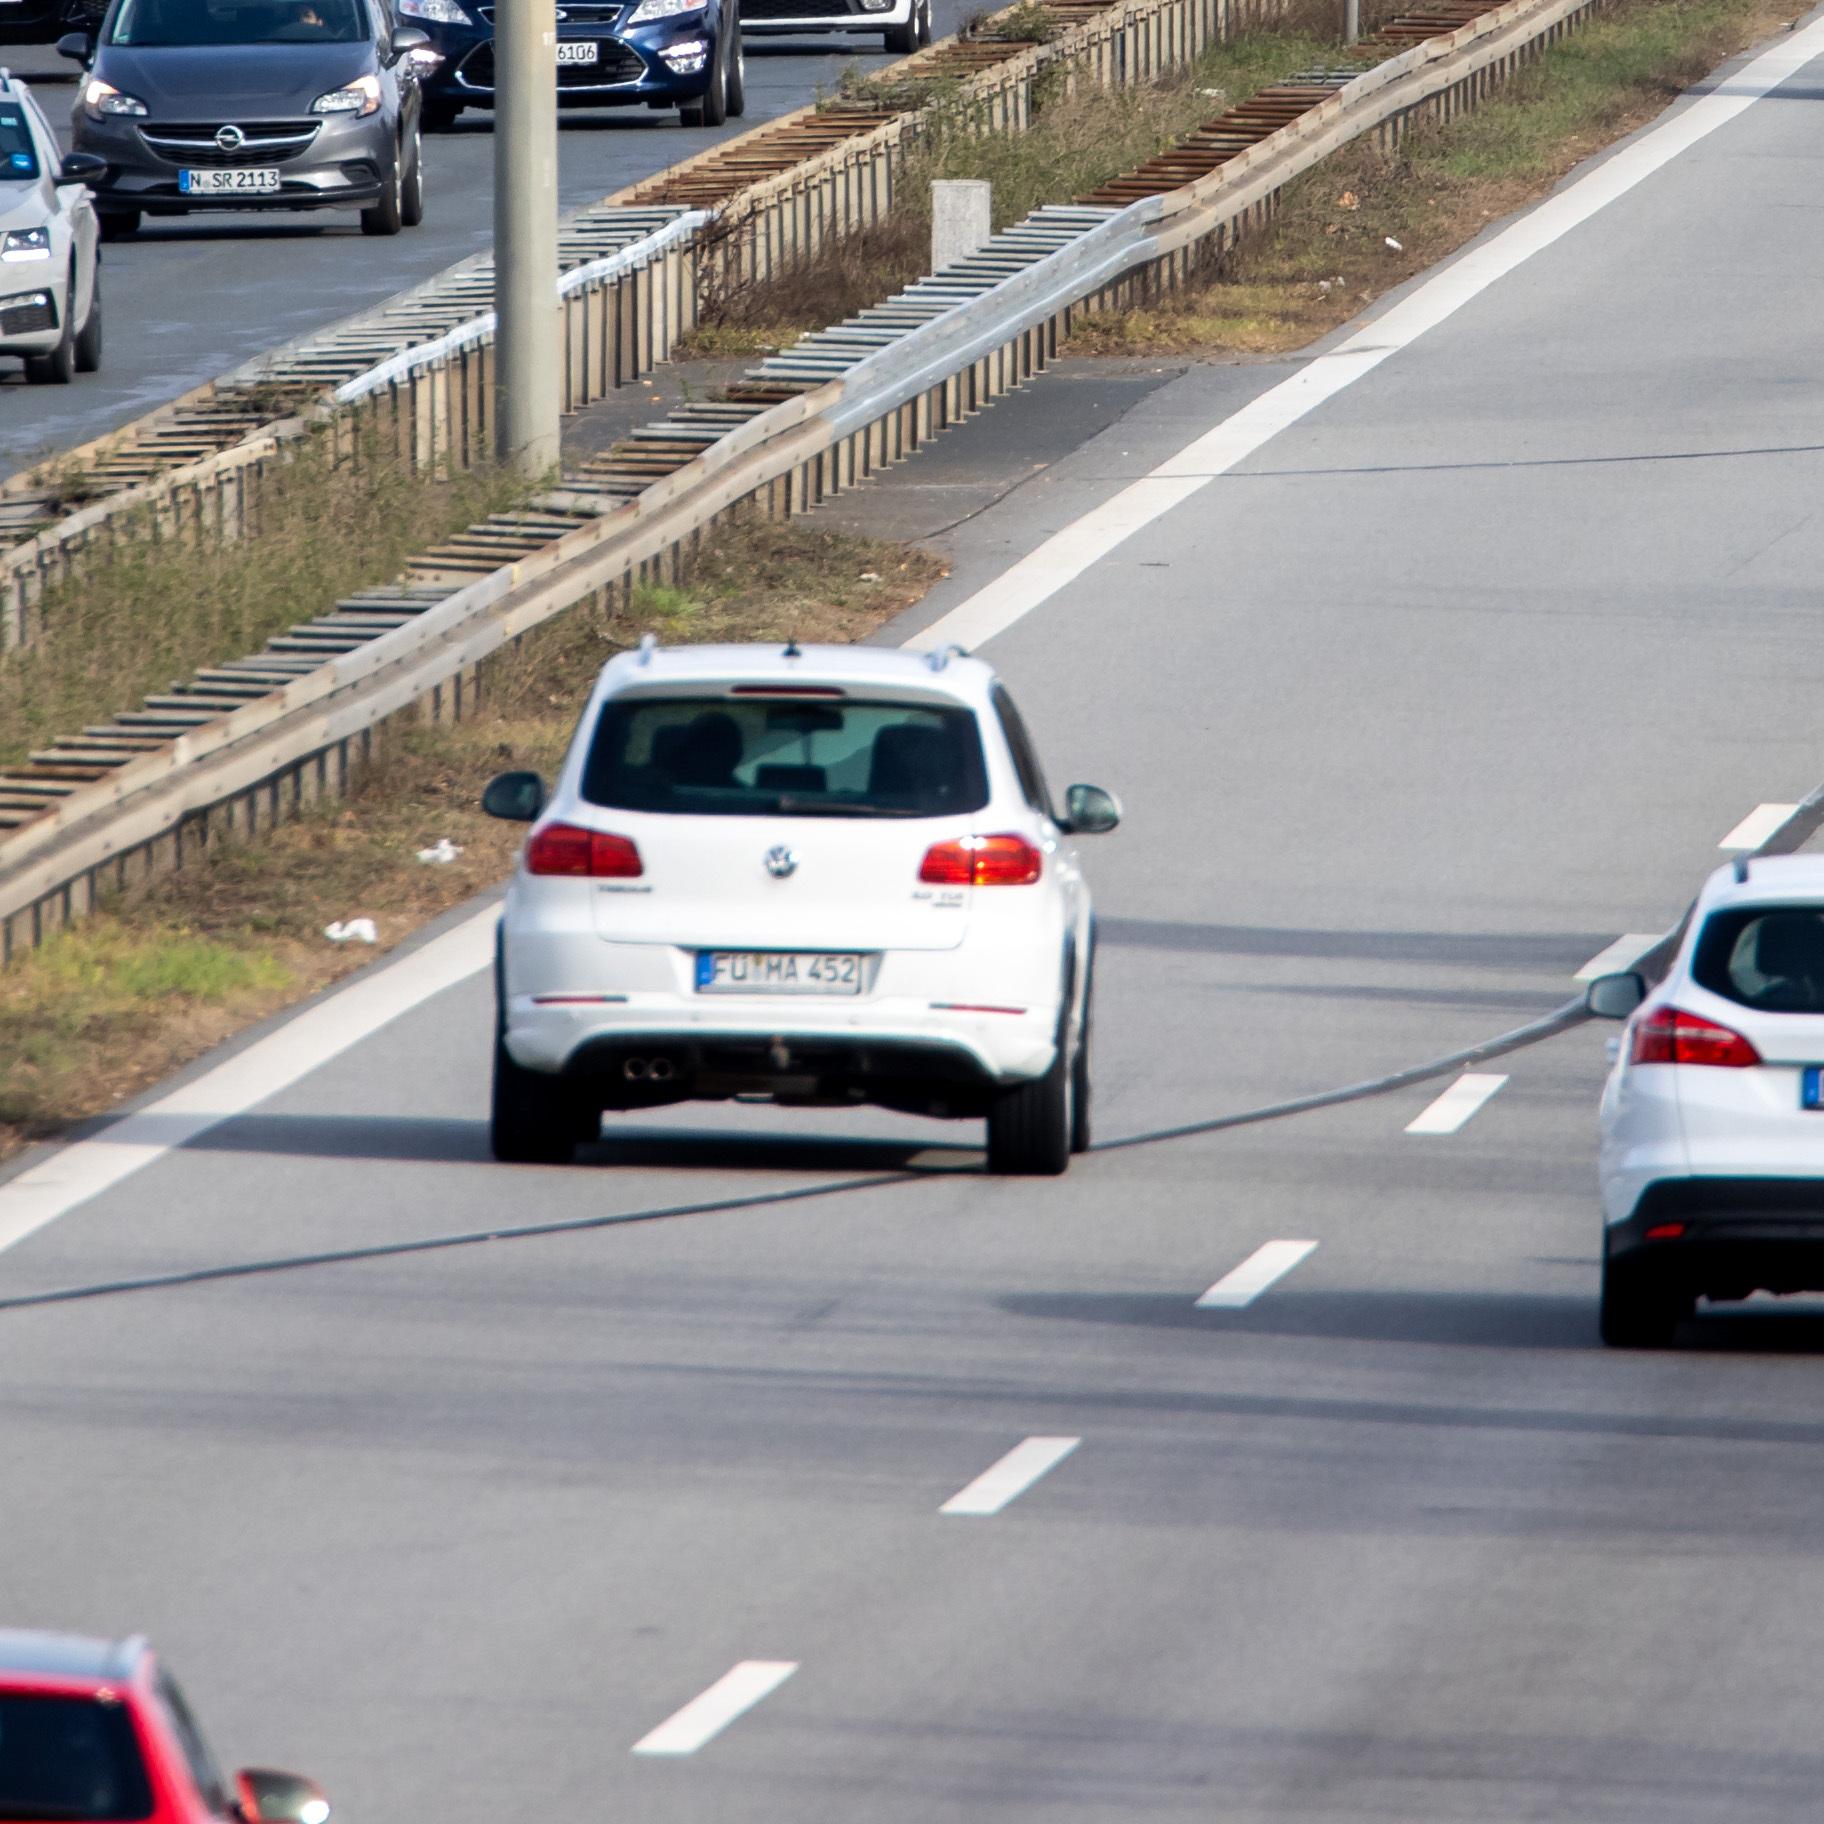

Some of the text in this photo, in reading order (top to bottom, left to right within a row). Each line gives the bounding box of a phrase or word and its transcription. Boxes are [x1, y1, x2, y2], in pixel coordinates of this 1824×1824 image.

[558, 45, 595, 60] 6106
[212, 173, 232, 188] SR
[236, 171, 278, 187] 2113
[808, 956, 856, 983] 452
